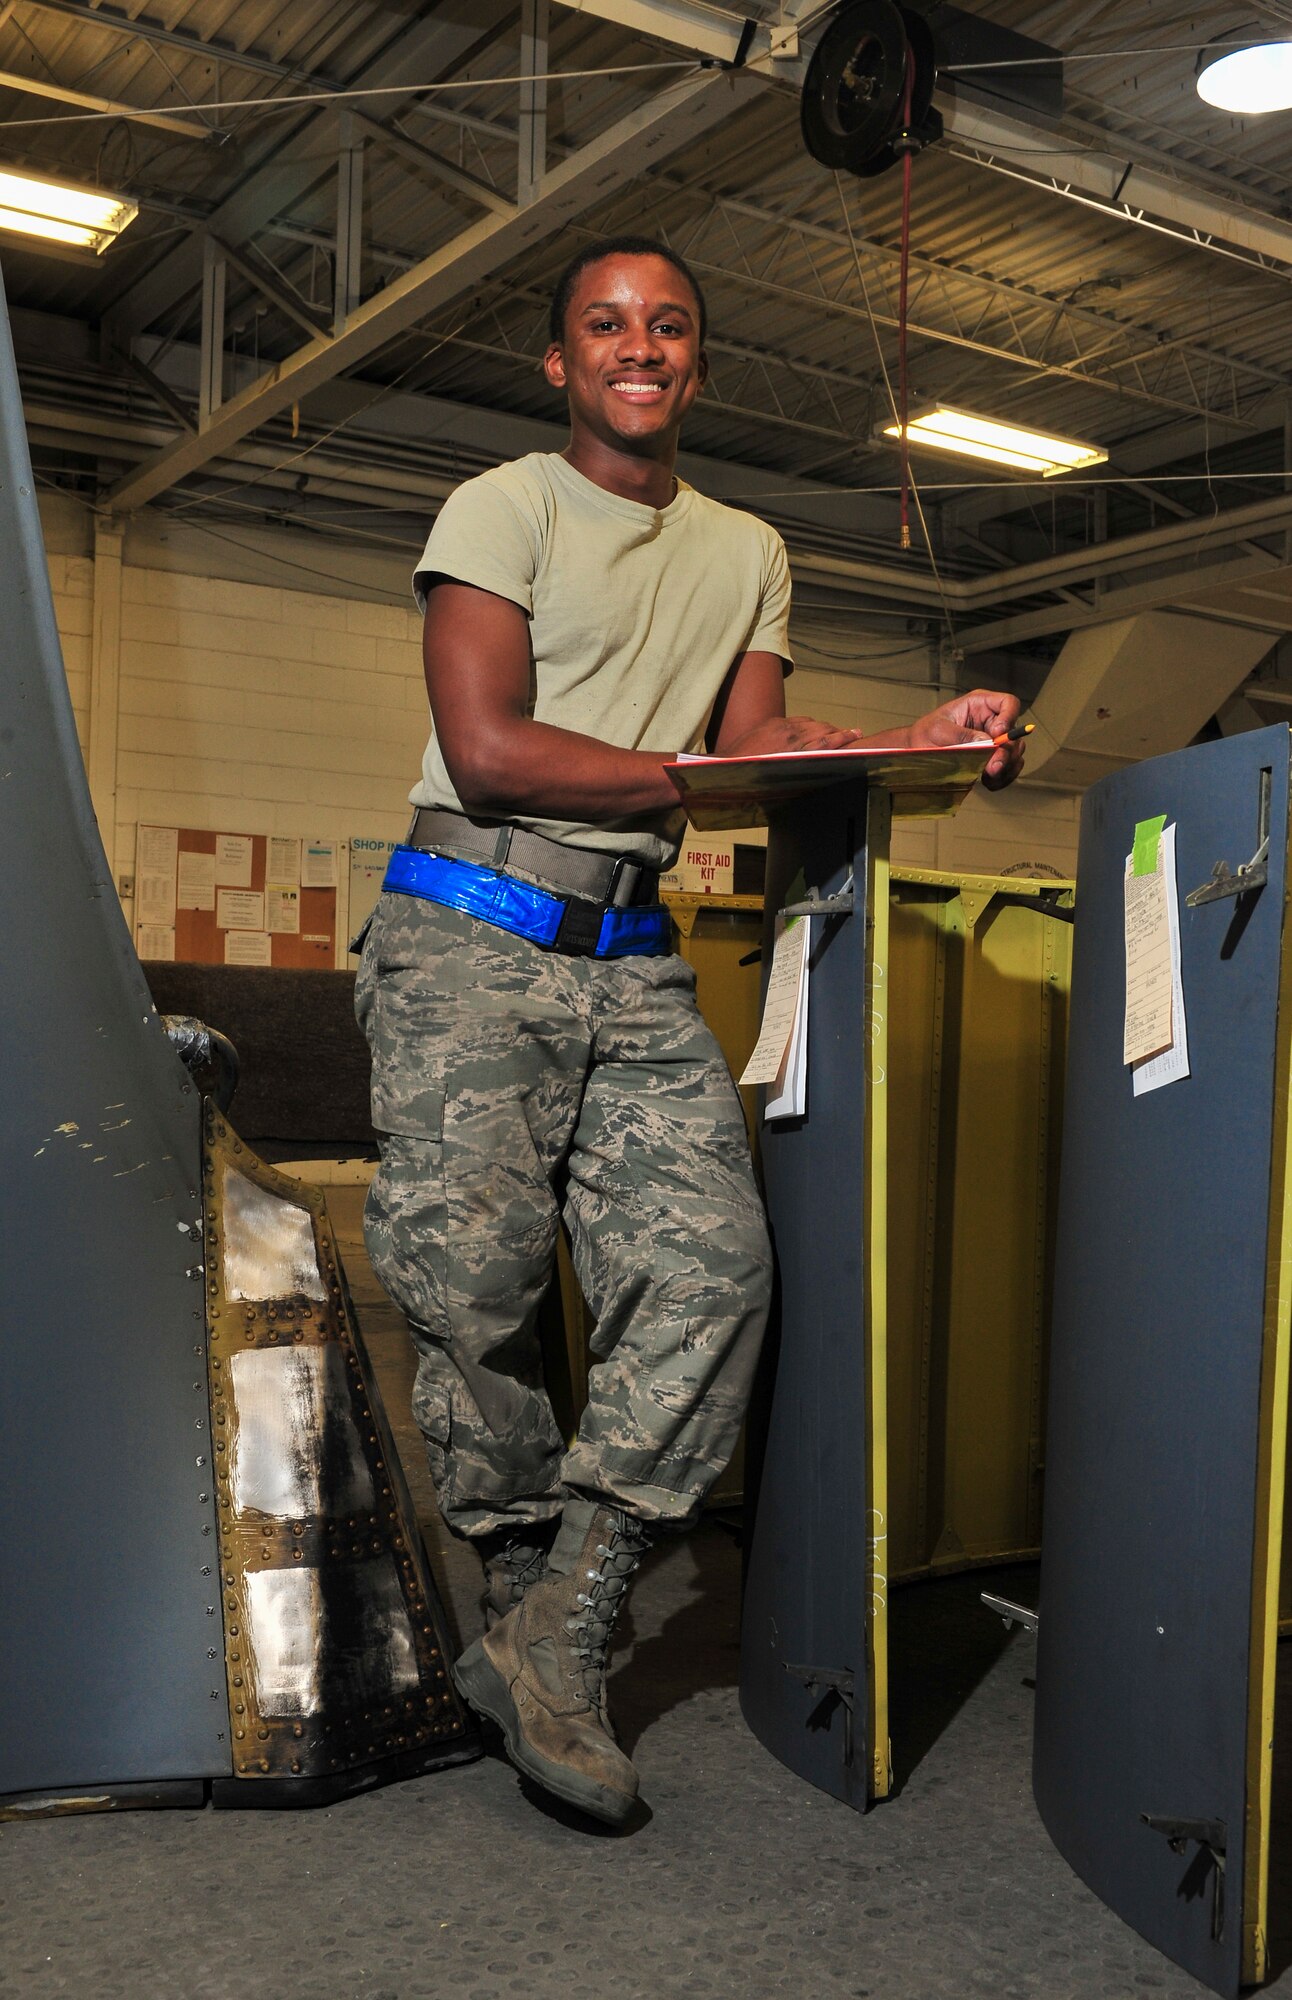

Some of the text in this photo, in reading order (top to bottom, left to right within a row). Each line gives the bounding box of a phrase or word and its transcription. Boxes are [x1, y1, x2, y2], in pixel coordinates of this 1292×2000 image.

[353, 839, 385, 851] SHOP
[687, 851, 731, 868] FIRST AID
[700, 867, 715, 881] KIT
